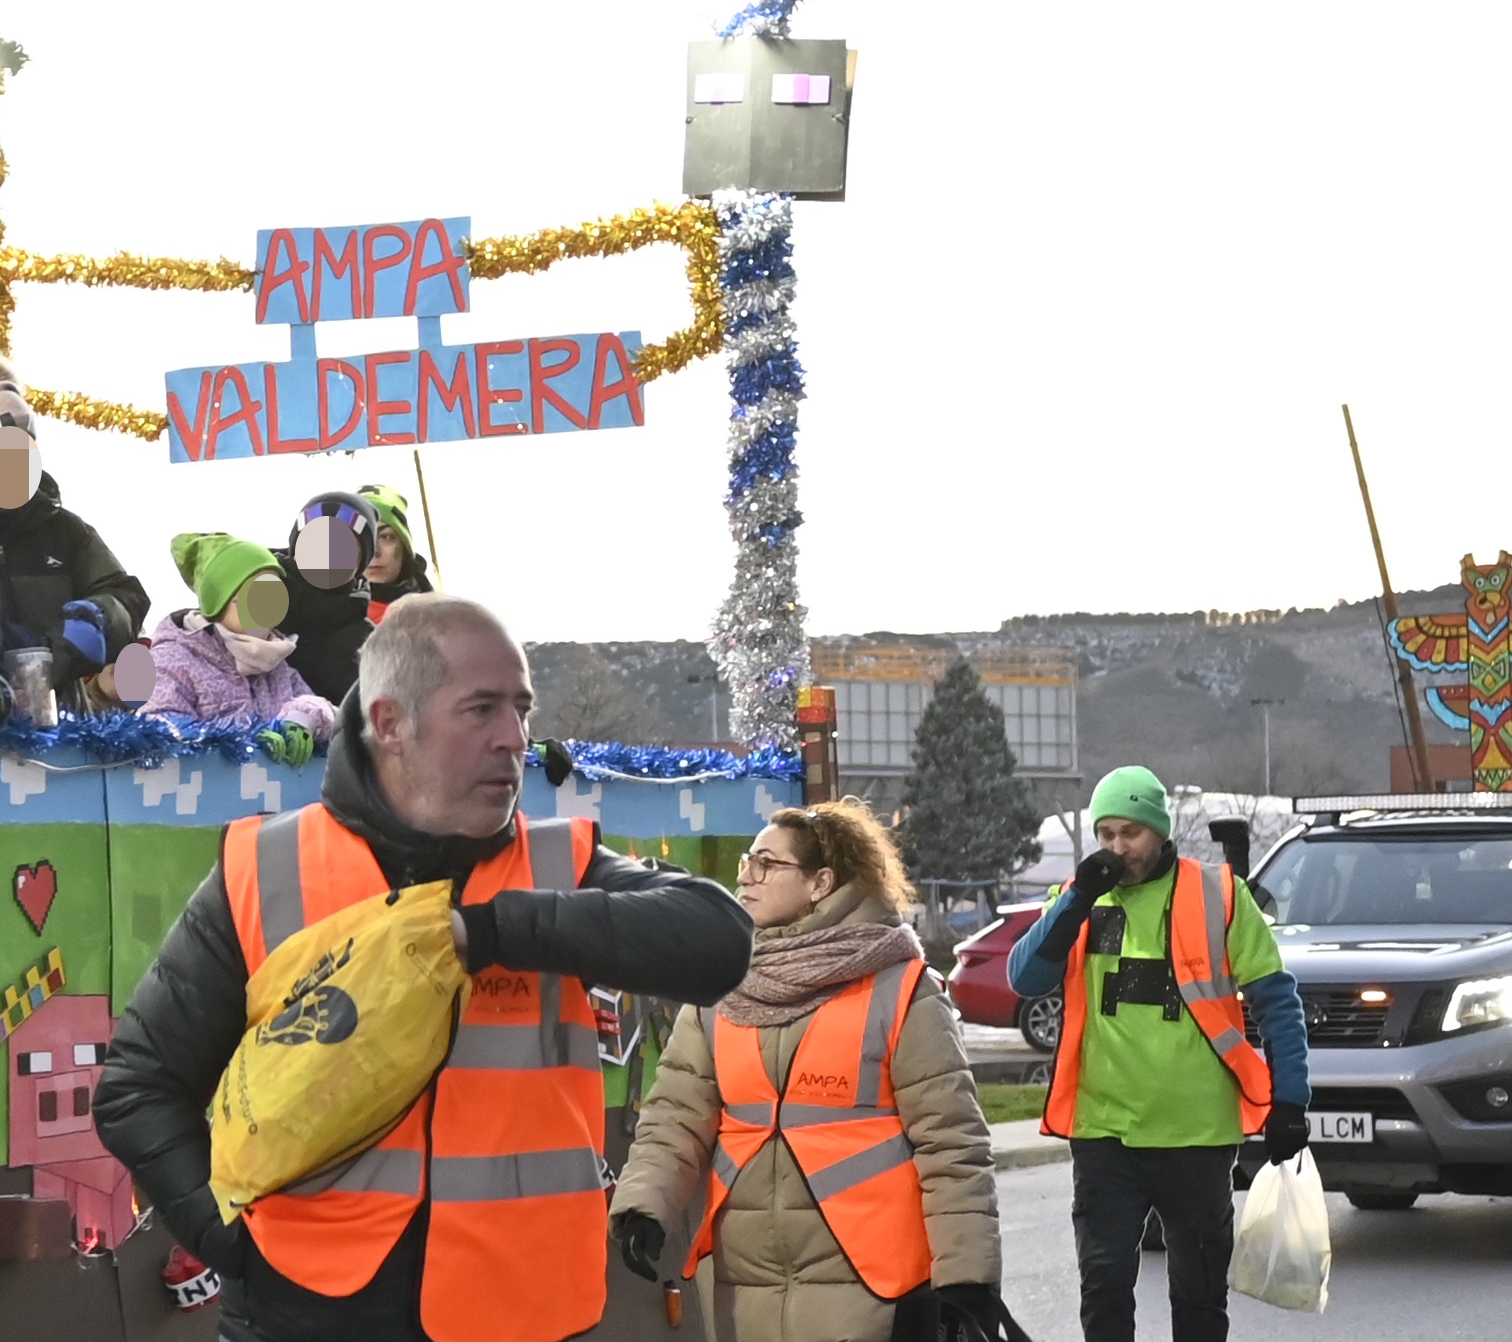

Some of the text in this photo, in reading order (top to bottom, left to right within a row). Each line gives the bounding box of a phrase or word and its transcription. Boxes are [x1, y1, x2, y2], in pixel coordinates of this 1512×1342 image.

[255, 218, 466, 324] AMPA
[166, 332, 646, 461] VALDEMERA
[471, 976, 531, 998] MPA
[797, 1071, 849, 1090] AMPA
[1320, 1116, 1366, 1139] LCM
